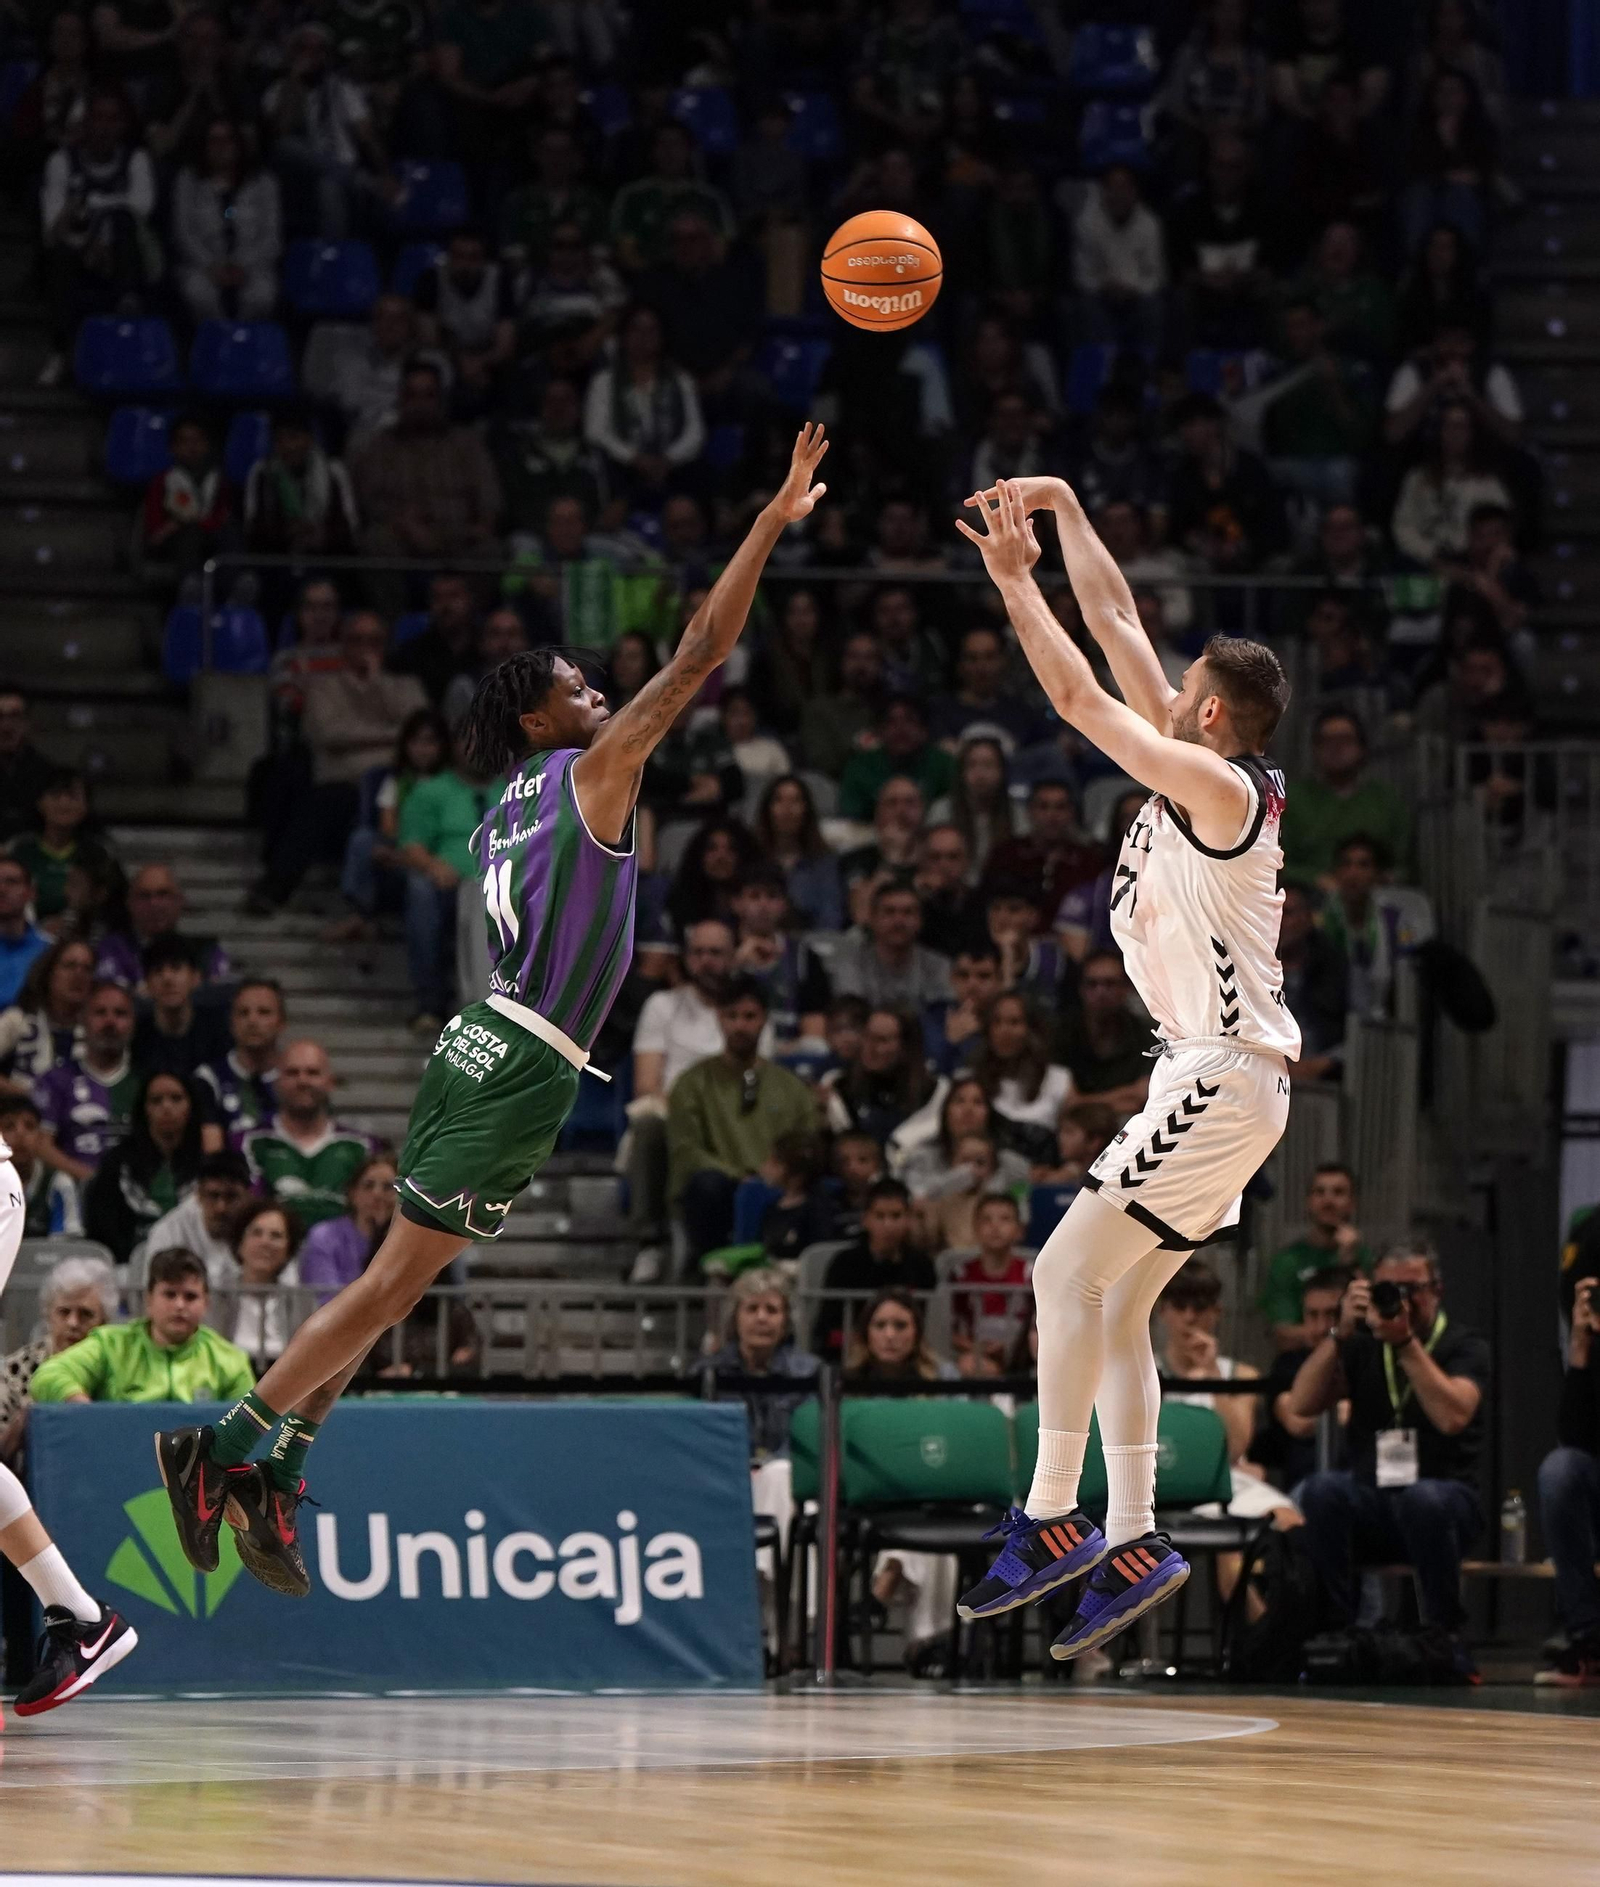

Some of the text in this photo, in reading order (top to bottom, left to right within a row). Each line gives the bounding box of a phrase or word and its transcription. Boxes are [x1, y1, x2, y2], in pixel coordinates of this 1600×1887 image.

[843, 289, 923, 314] Wilson
[500, 772, 547, 805] arter
[452, 1035, 495, 1072] DEL SOL
[462, 1024, 508, 1059] COSTA
[445, 1048, 484, 1083] MÁLAGA
[316, 1509, 703, 1626] Unicaja
